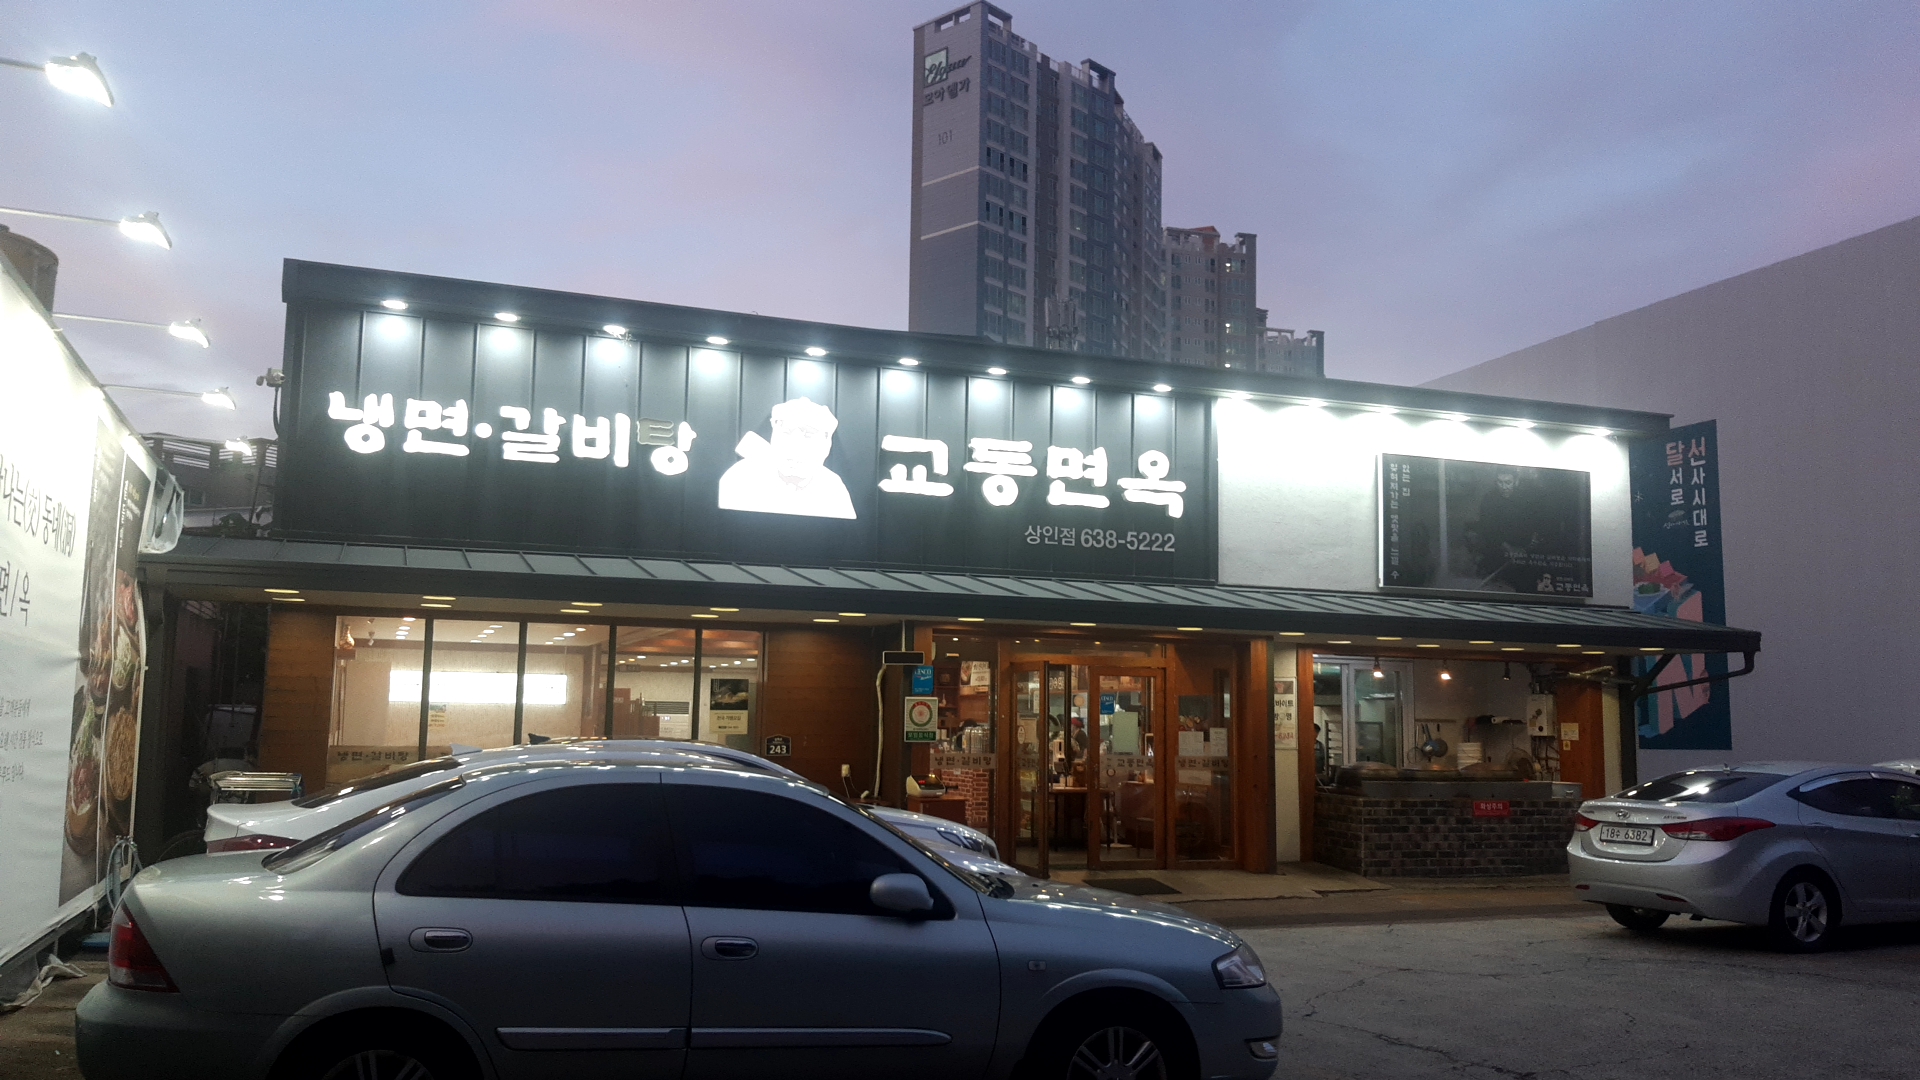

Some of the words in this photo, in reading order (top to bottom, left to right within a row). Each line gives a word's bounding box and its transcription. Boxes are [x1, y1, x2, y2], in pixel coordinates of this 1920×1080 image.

[938, 130, 953, 146] 101
[877, 434, 1187, 519] 교동면옥
[1665, 440, 1686, 506] 달서로
[1402, 487, 1411, 497] 집
[1688, 436, 1709, 548] 선사시대로
[1024, 525, 1076, 547] 상인점
[1080, 528, 1176, 553] 638-5222
[769, 745, 787, 754] 243
[1480, 802, 1503, 811] 화상주의
[1606, 828, 1621, 839] 18수
[1624, 829, 1649, 842] 6382
